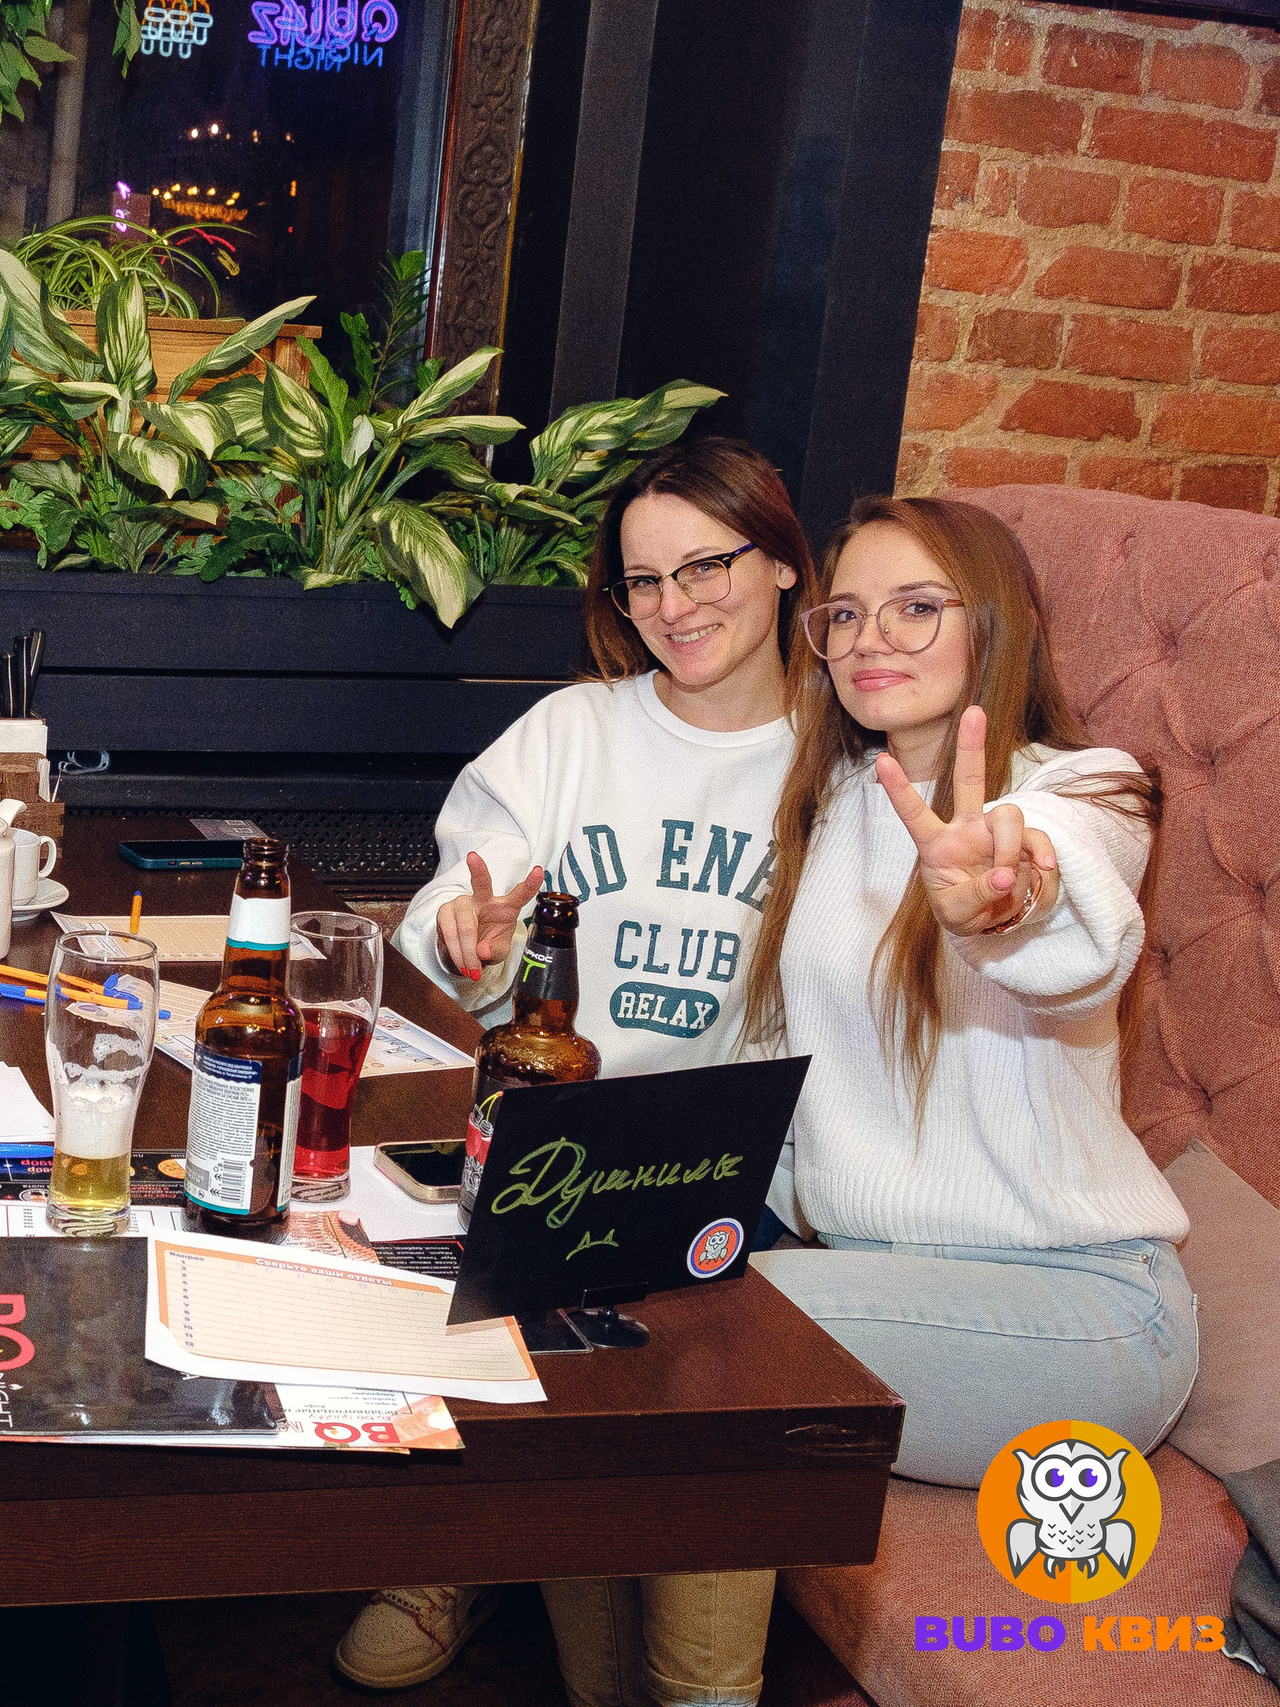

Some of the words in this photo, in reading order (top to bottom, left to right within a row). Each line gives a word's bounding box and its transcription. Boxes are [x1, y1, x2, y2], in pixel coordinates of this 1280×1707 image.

[614, 920, 740, 982] CLUB
[617, 990, 713, 1030] RELAX
[256, 1258, 308, 1273] Сверьте
[311, 1267, 344, 1279] ваши
[347, 1273, 393, 1287] ответы
[312, 1421, 401, 1444] BQ
